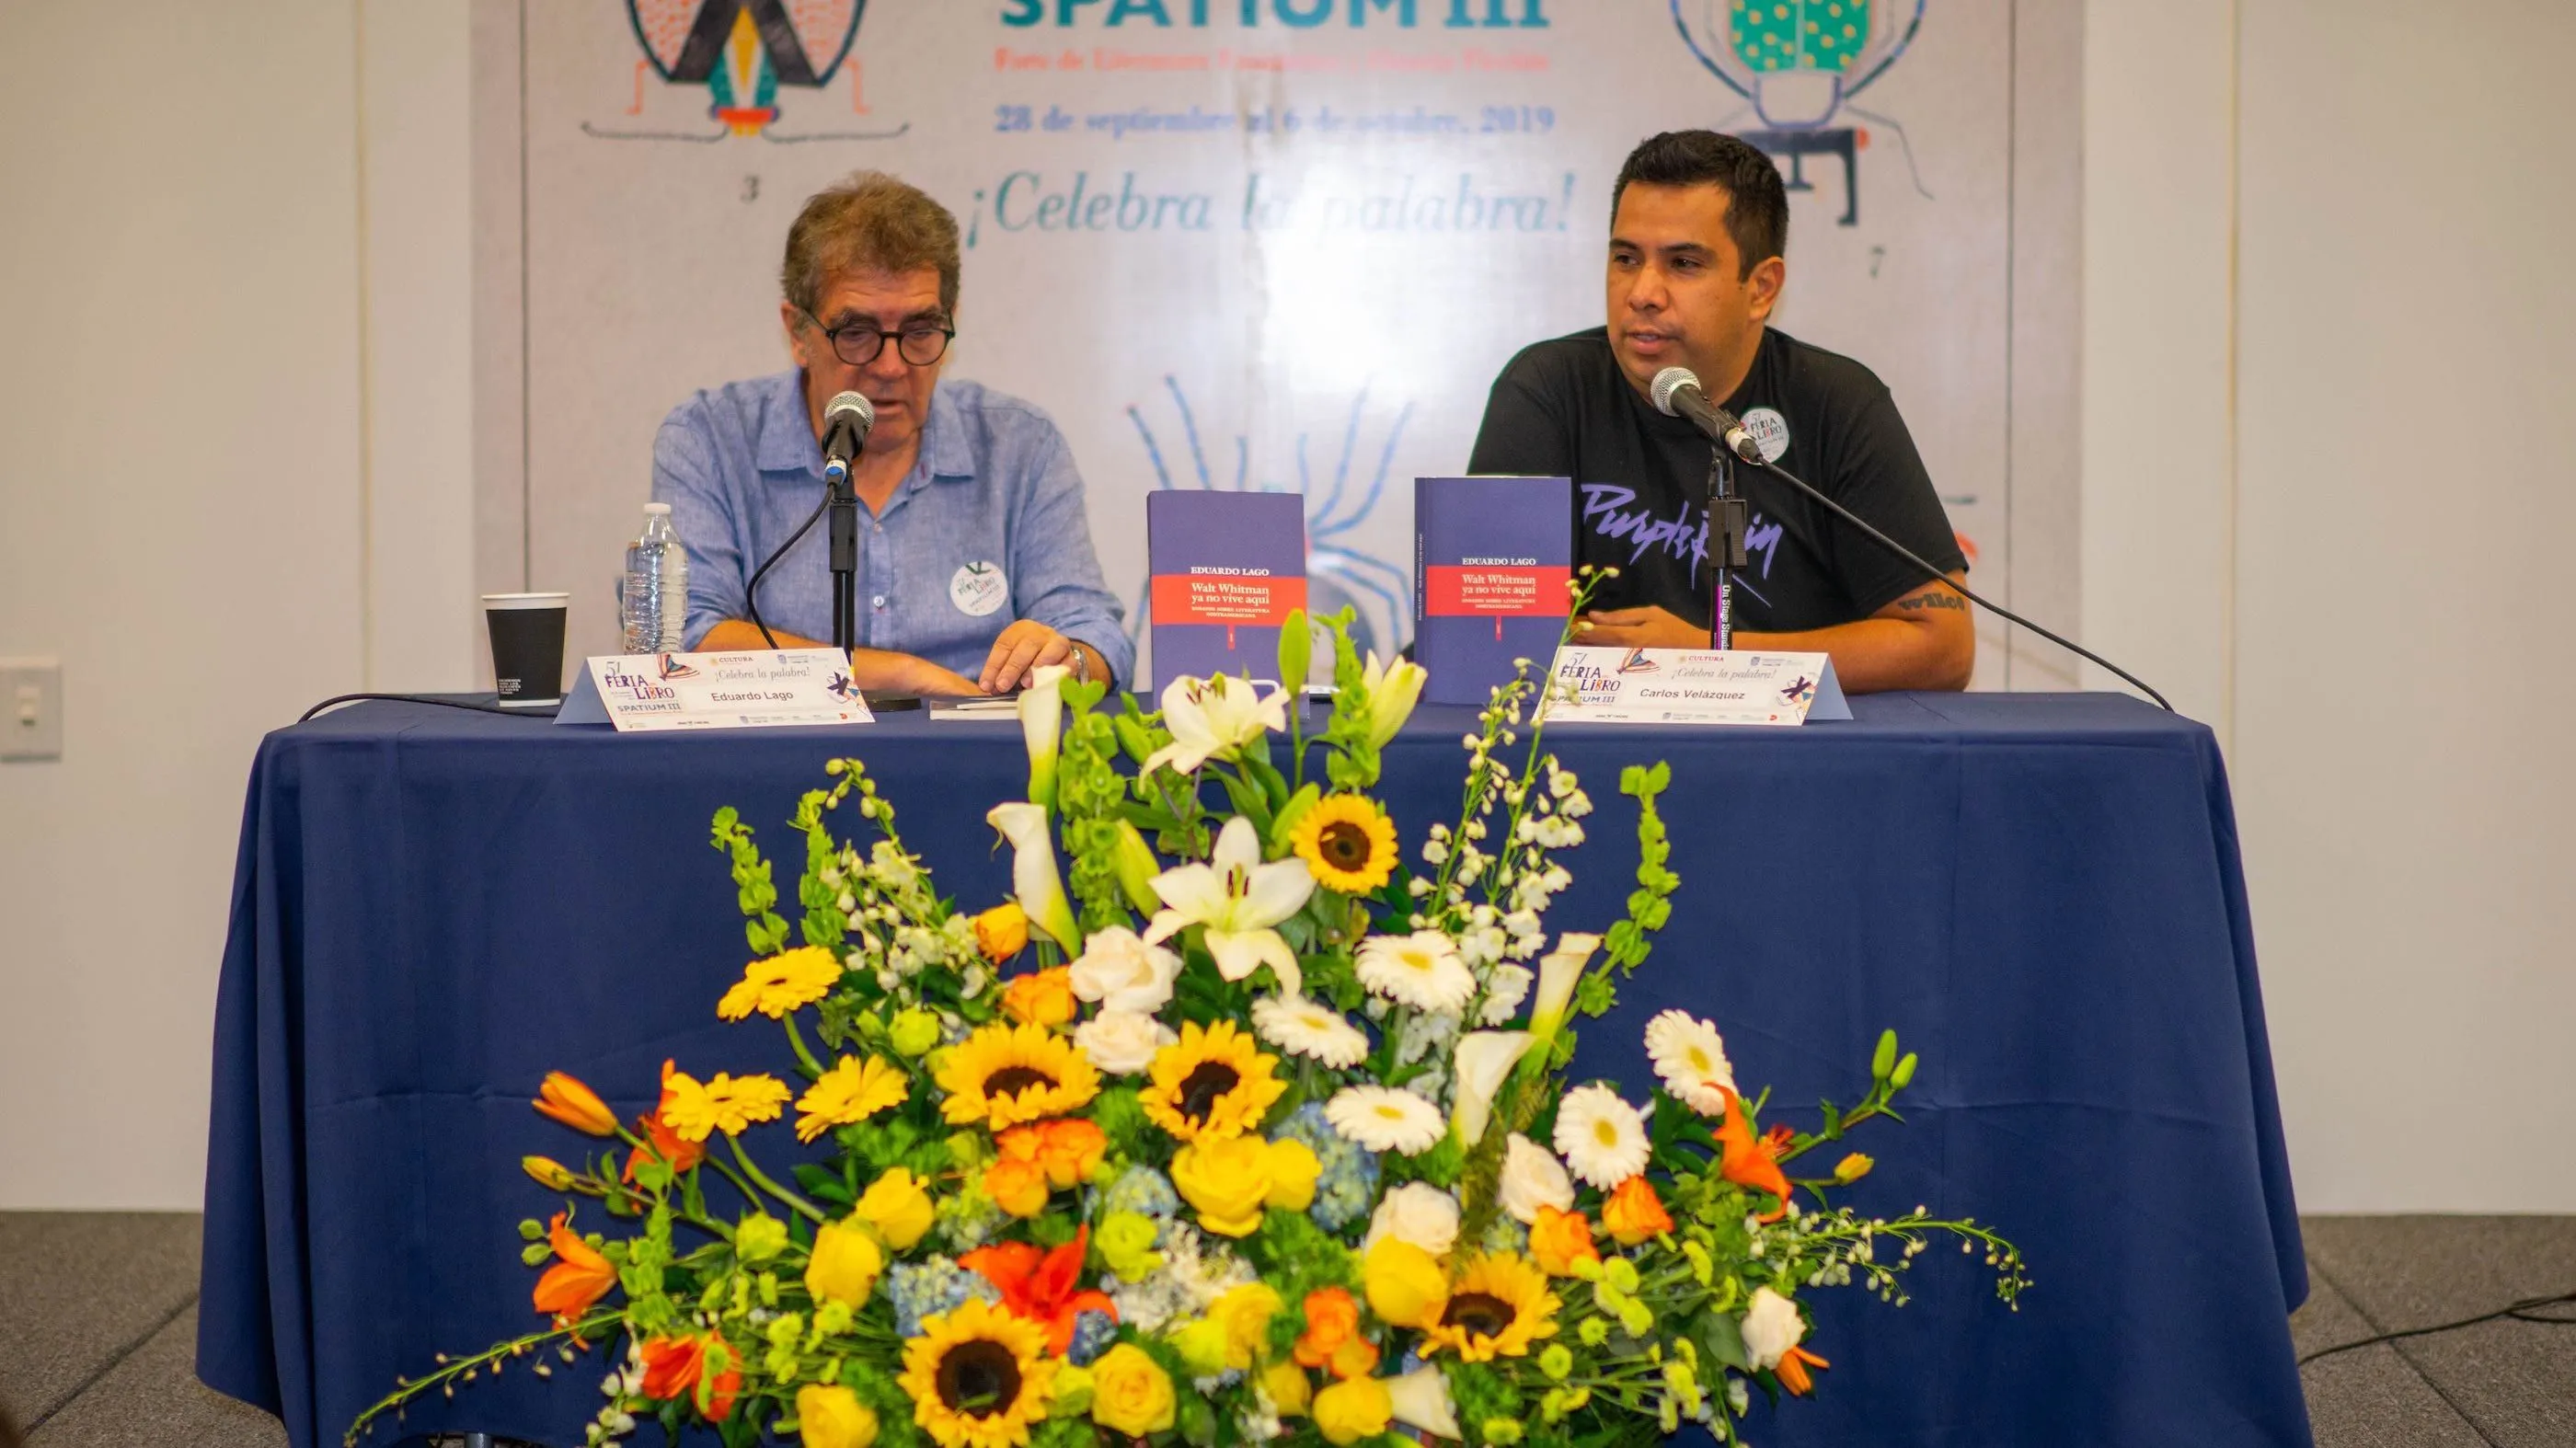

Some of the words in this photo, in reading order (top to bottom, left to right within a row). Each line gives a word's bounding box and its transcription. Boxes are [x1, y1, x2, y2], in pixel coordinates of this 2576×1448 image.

[995, 104, 1032, 132] 28
[1041, 104, 1075, 132] de
[1085, 104, 1236, 140] septiembre
[1282, 107, 1302, 132] 6
[1480, 104, 1556, 132] 2019
[740, 172, 761, 204] 3
[966, 171, 1214, 249] ¡Celebra
[1869, 244, 1886, 280] 7
[1462, 557, 1509, 566] EDUARDO
[1511, 557, 1536, 566] LAGO
[1190, 567, 1240, 575] EDUARDO
[1462, 574, 1485, 584] Walt
[1487, 574, 1535, 585] Whitman
[1191, 582, 1216, 593] Walt
[1218, 583, 1270, 594] Whitman
[1462, 586, 1474, 596] ya
[1490, 585, 1512, 594] vive
[1512, 584, 1536, 596] aquí
[1722, 584, 1731, 598] On
[1191, 594, 1203, 604] ya
[1222, 594, 1244, 603] vive
[1245, 594, 1270, 607] aquí
[1720, 599, 1731, 623] Stage
[605, 661, 621, 677] 51
[716, 670, 753, 683] ¡Celebra
[757, 670, 767, 678] la
[770, 667, 811, 681] palabra!
[1559, 664, 1602, 679] FERIA
[1672, 667, 1715, 680] ¡Celebra
[1718, 669, 1728, 678] la
[1730, 669, 1777, 682] palabra!
[604, 674, 650, 688] FERIA
[711, 692, 762, 702] Eduardo
[765, 690, 794, 702] Lago
[1639, 689, 1679, 699] Carlos
[1684, 689, 1745, 701] Velázquez
[617, 704, 668, 713] SPATIUM
[669, 703, 682, 711] III
